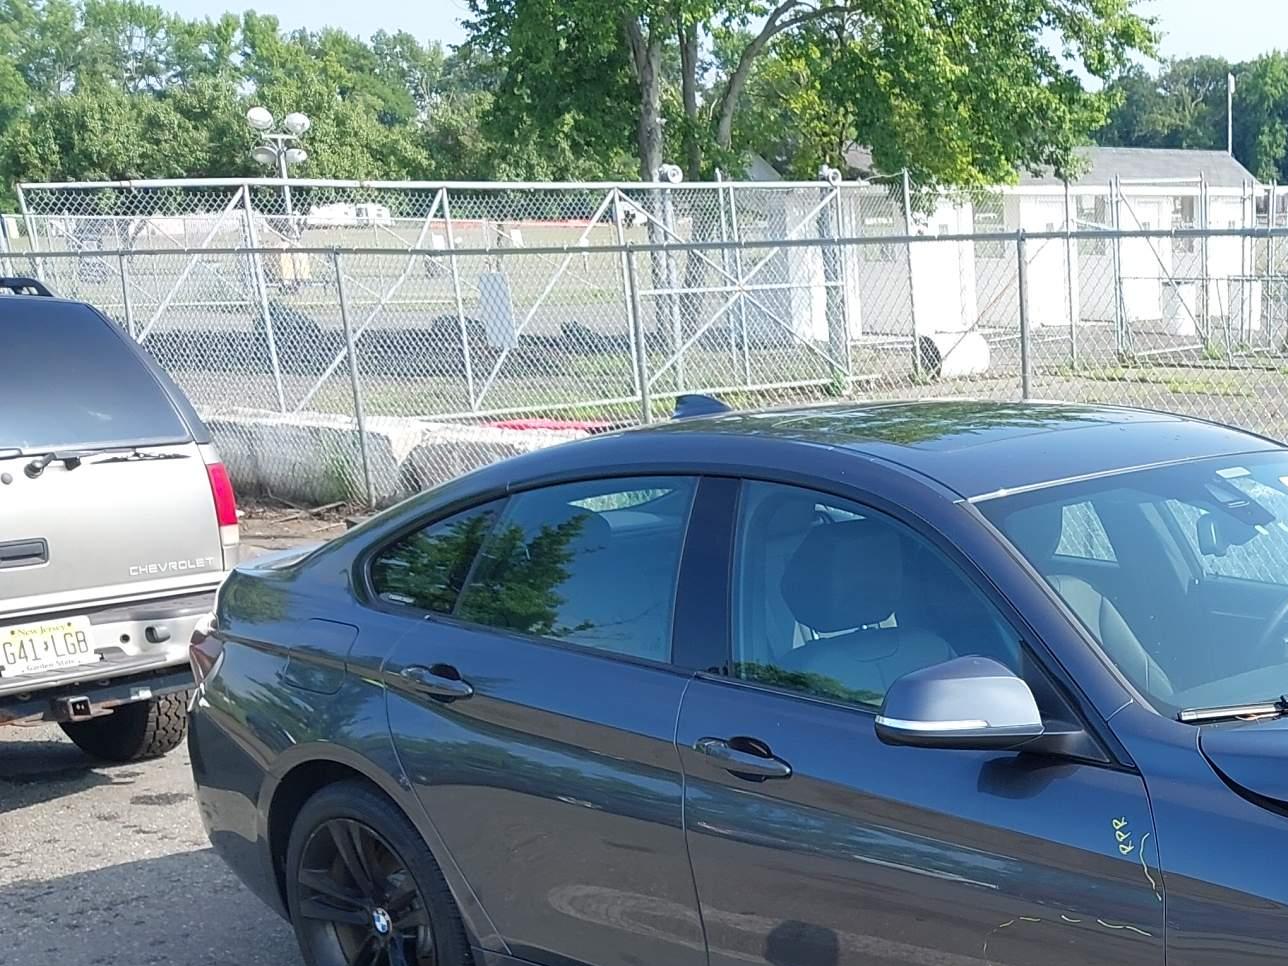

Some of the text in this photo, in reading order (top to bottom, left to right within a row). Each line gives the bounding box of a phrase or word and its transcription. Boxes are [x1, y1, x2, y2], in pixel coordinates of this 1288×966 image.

[129, 557, 215, 576] CHEVROLET
[17, 624, 66, 636] New Jersey
